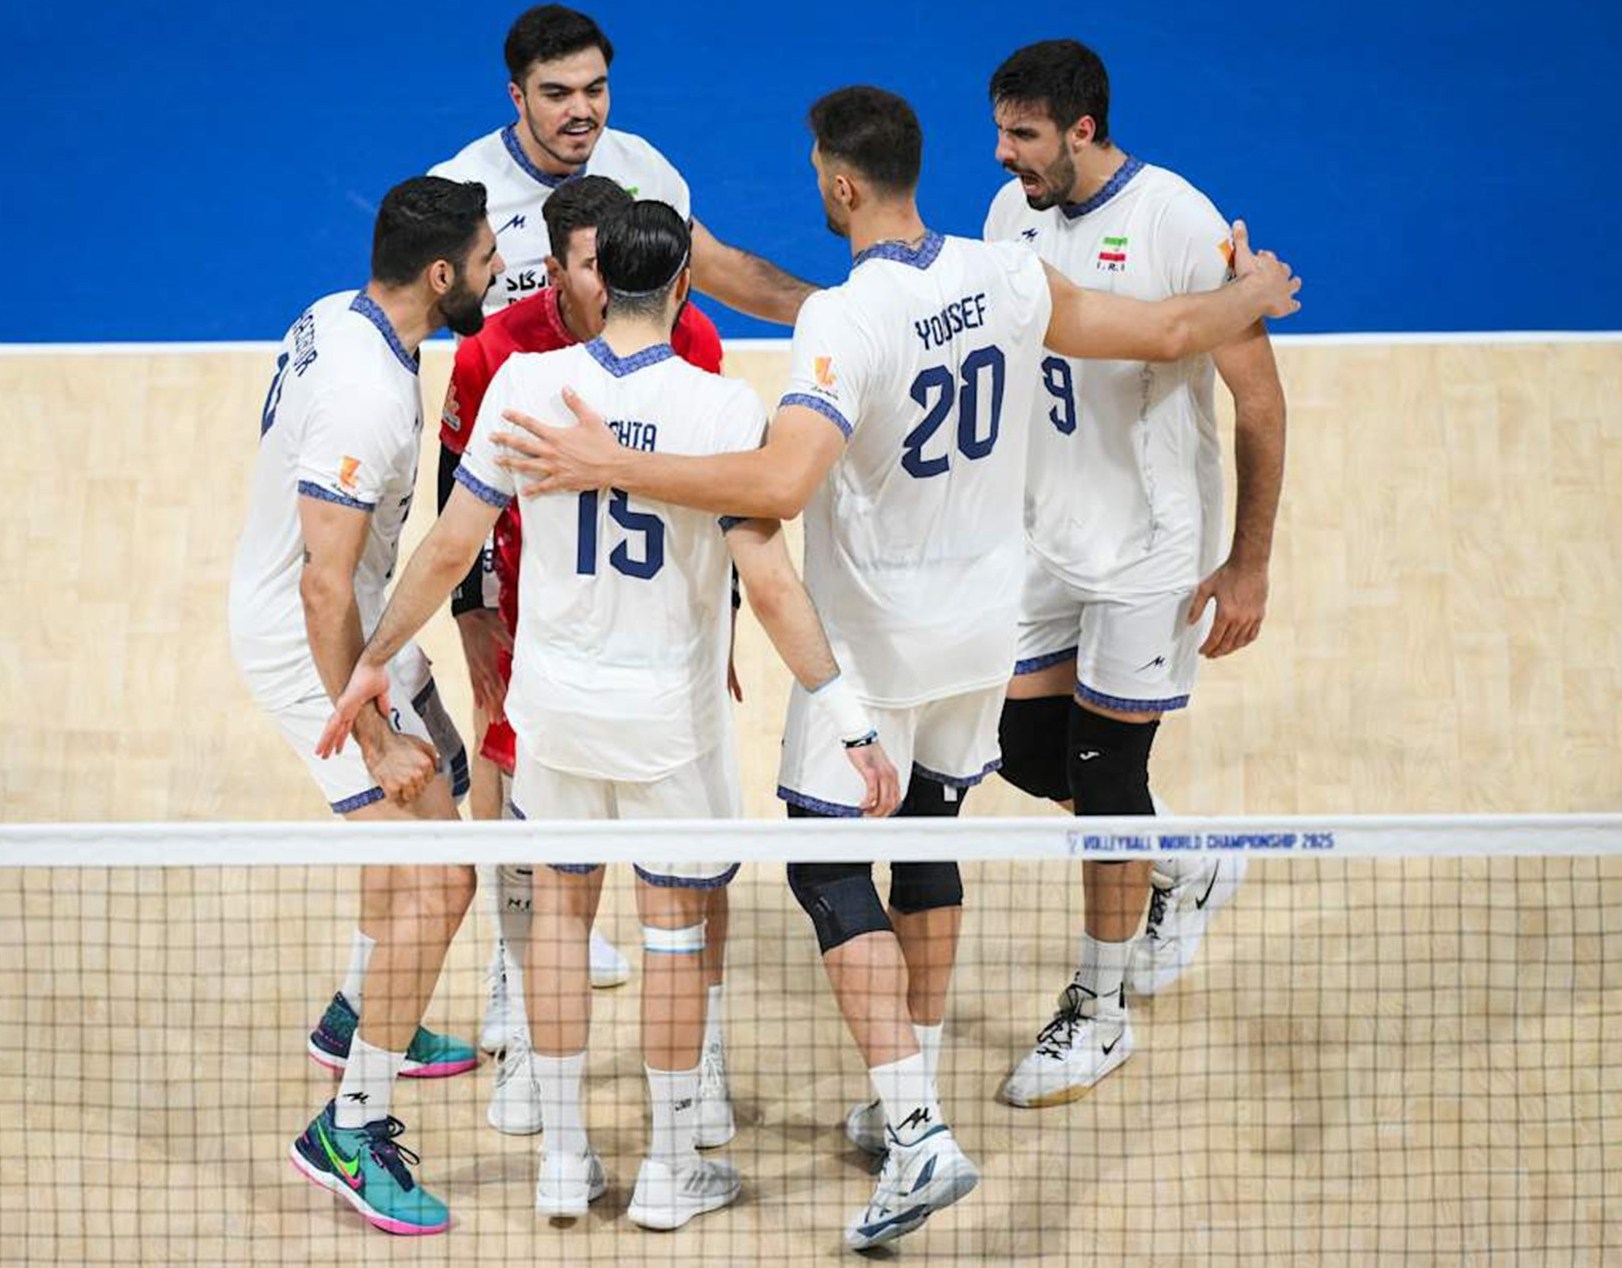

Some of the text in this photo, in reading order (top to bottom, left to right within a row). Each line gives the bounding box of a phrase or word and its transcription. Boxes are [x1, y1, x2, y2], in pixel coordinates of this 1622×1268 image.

[901, 344, 1006, 479] 20
[1041, 356, 1077, 436] 9
[576, 486, 665, 580] 15
[1083, 832, 1334, 851] VOLLEYBALL WORLD CHAMPIONSHIP 2025
